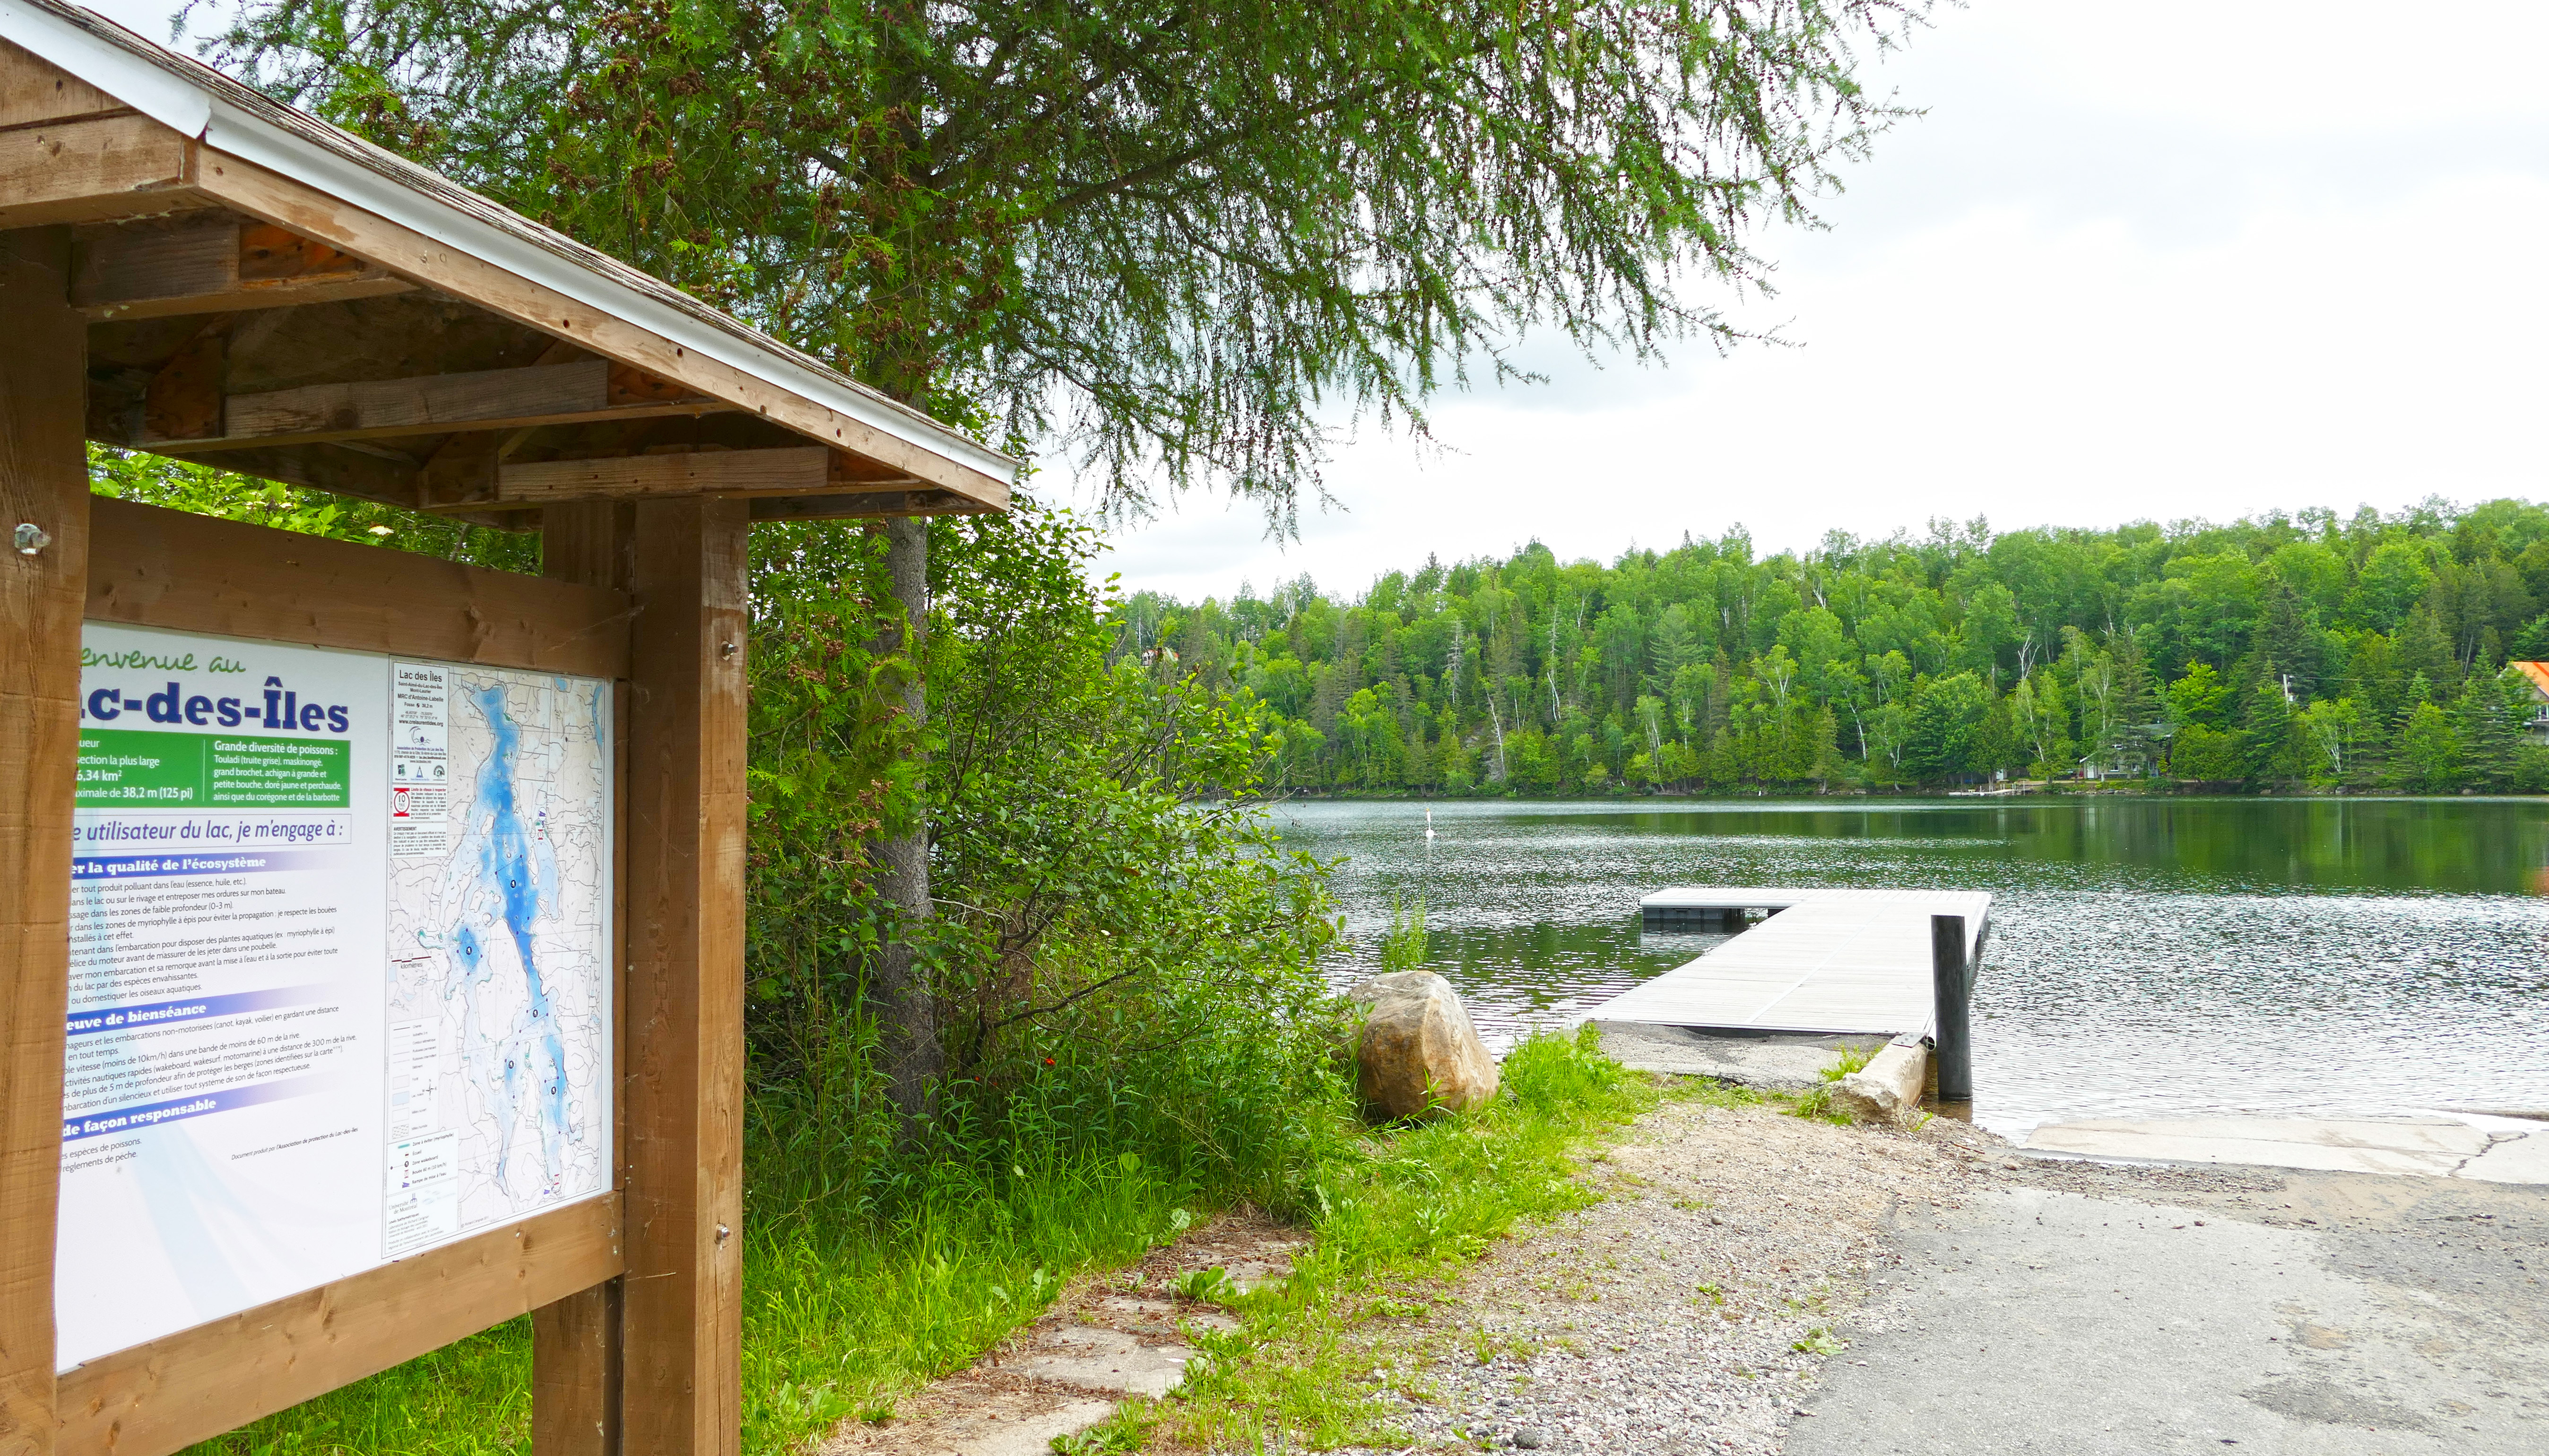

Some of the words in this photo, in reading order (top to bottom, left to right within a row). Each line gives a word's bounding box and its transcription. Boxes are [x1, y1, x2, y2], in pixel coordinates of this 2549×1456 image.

[81, 647, 198, 671] envenue
[209, 656, 246, 673] au
[399, 669, 413, 679] Lac
[415, 671, 427, 681] des
[430, 670, 442, 682] Îles
[81, 676, 349, 733] c-des-Îles
[215, 740, 247, 751] Grande
[249, 742, 285, 752] diversité
[286, 743, 297, 753] de
[299, 745, 333, 755] poissons
[110, 754, 117, 764] la
[119, 755, 137, 767] plus
[139, 755, 159, 768] large
[214, 754, 239, 763] Touladi
[241, 755, 261, 764] (truite
[214, 767, 234, 777] grand
[265, 769, 290, 779] achigan
[296, 770, 319, 779] grande
[214, 780, 234, 789] petite
[264, 780, 280, 788] doré
[109, 788, 121, 797] de
[122, 787, 144, 798] 38,2
[147, 789, 157, 797] m
[159, 787, 178, 799] (125
[181, 787, 192, 800] pi)
[245, 792, 255, 800] du
[256, 793, 287, 802] corégone
[296, 792, 304, 800] de
[398, 795, 406, 803] 10
[87, 821, 176, 840] utilisateur
[181, 820, 200, 838] du
[236, 821, 250, 842] je
[255, 820, 322, 841] m'engage
[326, 819, 335, 836] à
[88, 862, 103, 873] la
[106, 859, 158, 875] qualité
[162, 859, 179, 870] de
[182, 857, 265, 870] l'écosystème
[97, 884, 122, 893] produit
[124, 882, 151, 892] polluant
[69, 912, 89, 920] ssage
[172, 903, 207, 914] profondeur
[209, 902, 222, 910] (0-3
[70, 934, 95, 942] nstallés
[96, 982, 108, 990] par
[124, 978, 150, 987] espèces
[82, 993, 127, 1002] domestiquer
[67, 1018, 102, 1030] euve
[105, 1014, 124, 1025] de
[128, 1005, 206, 1022] bienséance
[63, 1125, 80, 1136] de
[84, 1117, 127, 1132] façon
[130, 1096, 216, 1123] responsable
[69, 1147, 98, 1158] espèces
[62, 1159, 103, 1172] règlements
[389, 1201, 408, 1210] Université
